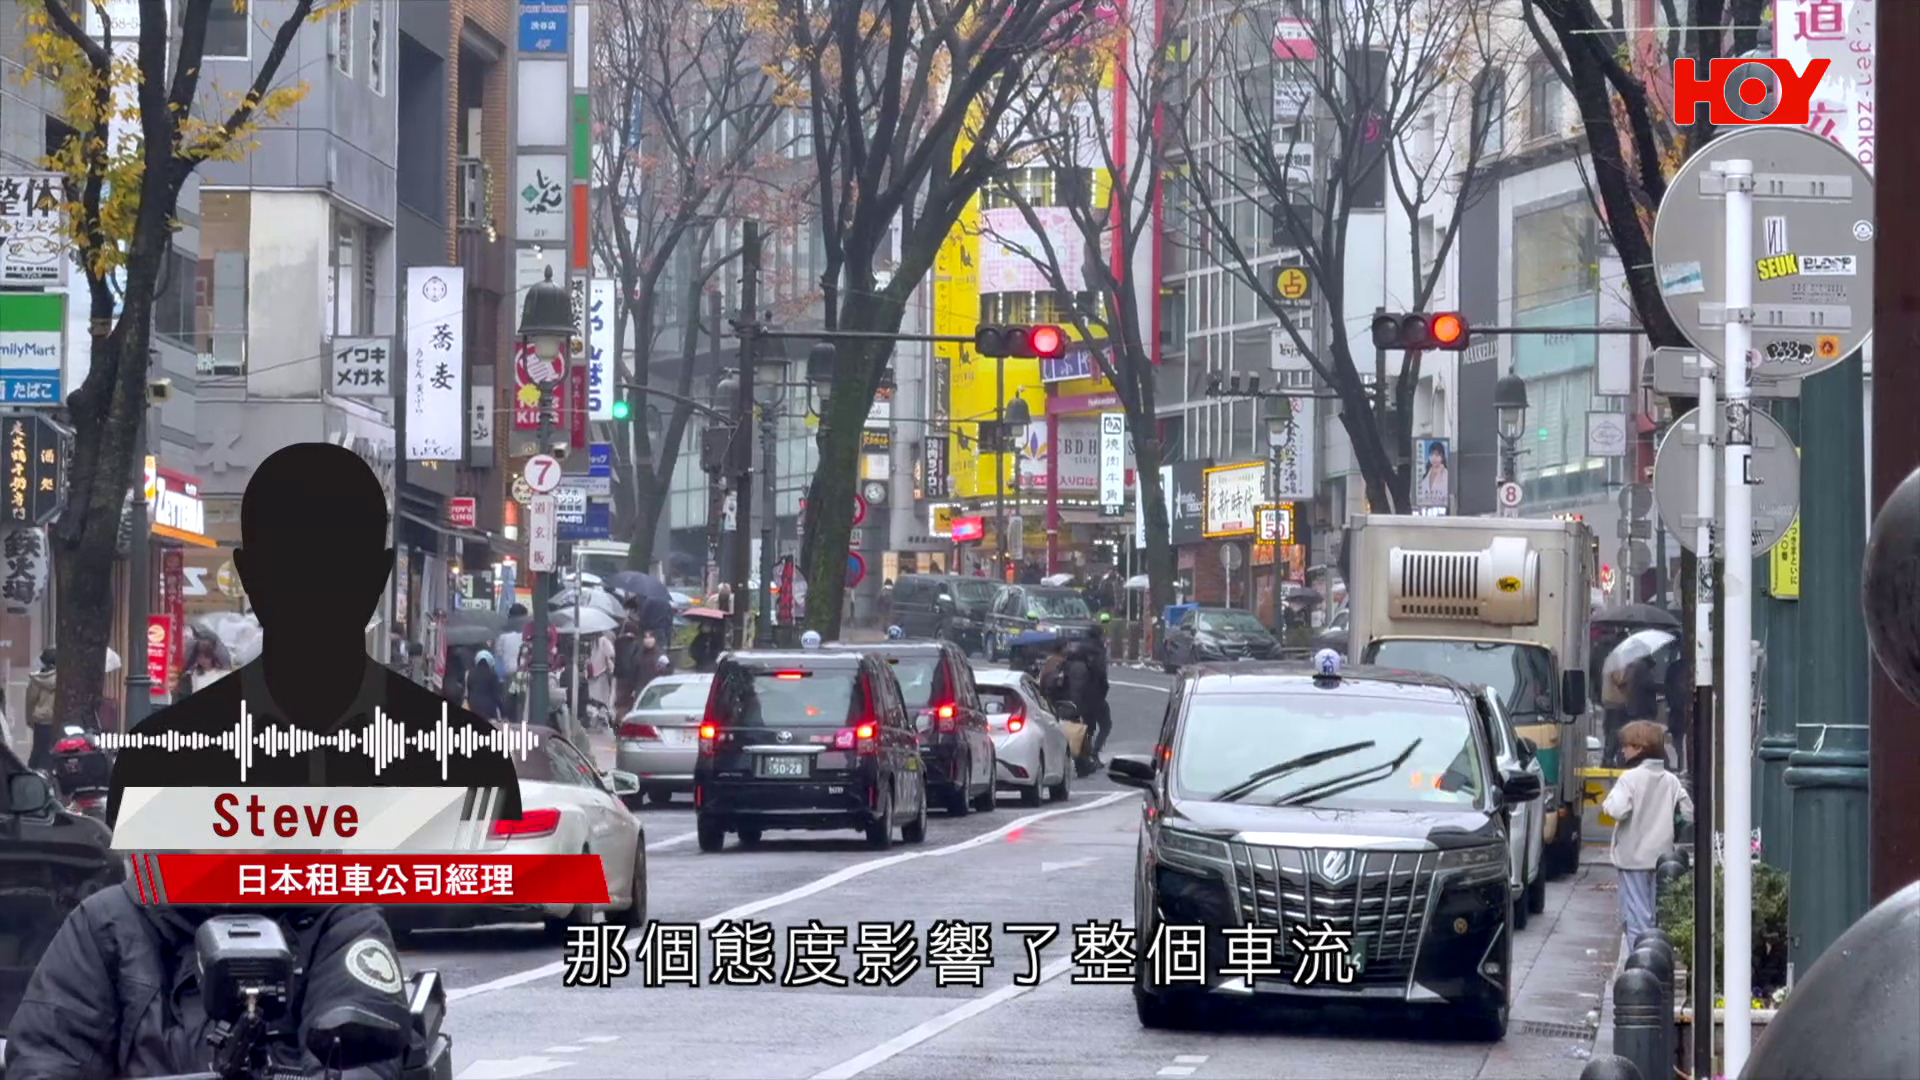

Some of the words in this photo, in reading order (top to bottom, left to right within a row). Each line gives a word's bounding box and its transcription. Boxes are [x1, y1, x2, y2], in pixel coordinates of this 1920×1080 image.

[1757, 254, 1797, 280] SEUK
[1283, 271, 1301, 294] 占
[337, 347, 386, 363] イワキ
[429, 323, 455, 390] 蕎麦
[337, 368, 386, 386] メガネ
[13, 382, 52, 398] たばこ
[517, 413, 559, 423] KIG
[534, 461, 552, 485] 7
[1105, 438, 1120, 501] 焼肉牛角
[1506, 486, 1516, 502] 8
